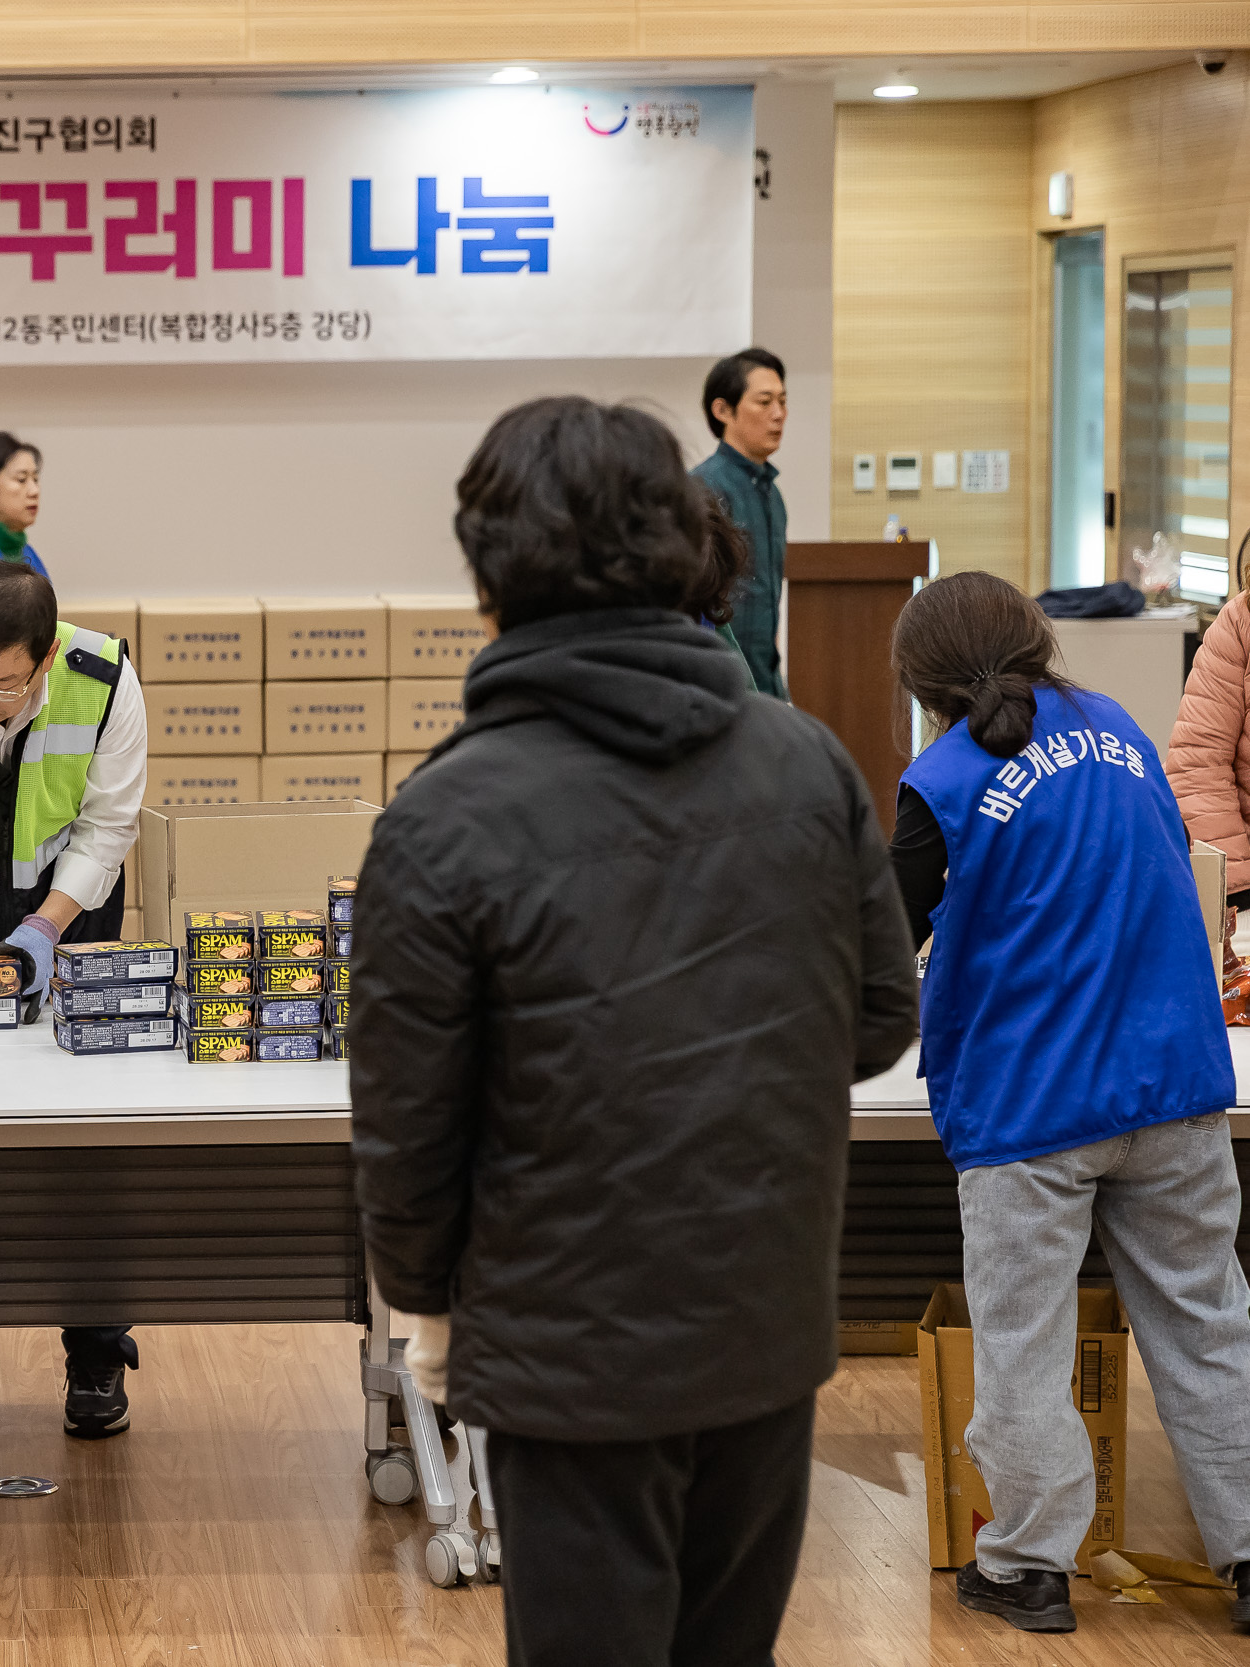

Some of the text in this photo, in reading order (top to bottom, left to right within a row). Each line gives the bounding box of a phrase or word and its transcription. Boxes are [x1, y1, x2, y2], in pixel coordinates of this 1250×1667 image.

[351, 177, 554, 275] 나눔
[312, 310, 372, 342] 강당)
[978, 729, 1145, 823] 바르게살기운동
[199, 934, 243, 947] SPAM
[271, 932, 314, 945] SPAM
[199, 968, 243, 982] SPAM
[270, 966, 313, 980] SPAM
[201, 1002, 244, 1015] SPAM
[198, 1036, 241, 1050] SPAM
